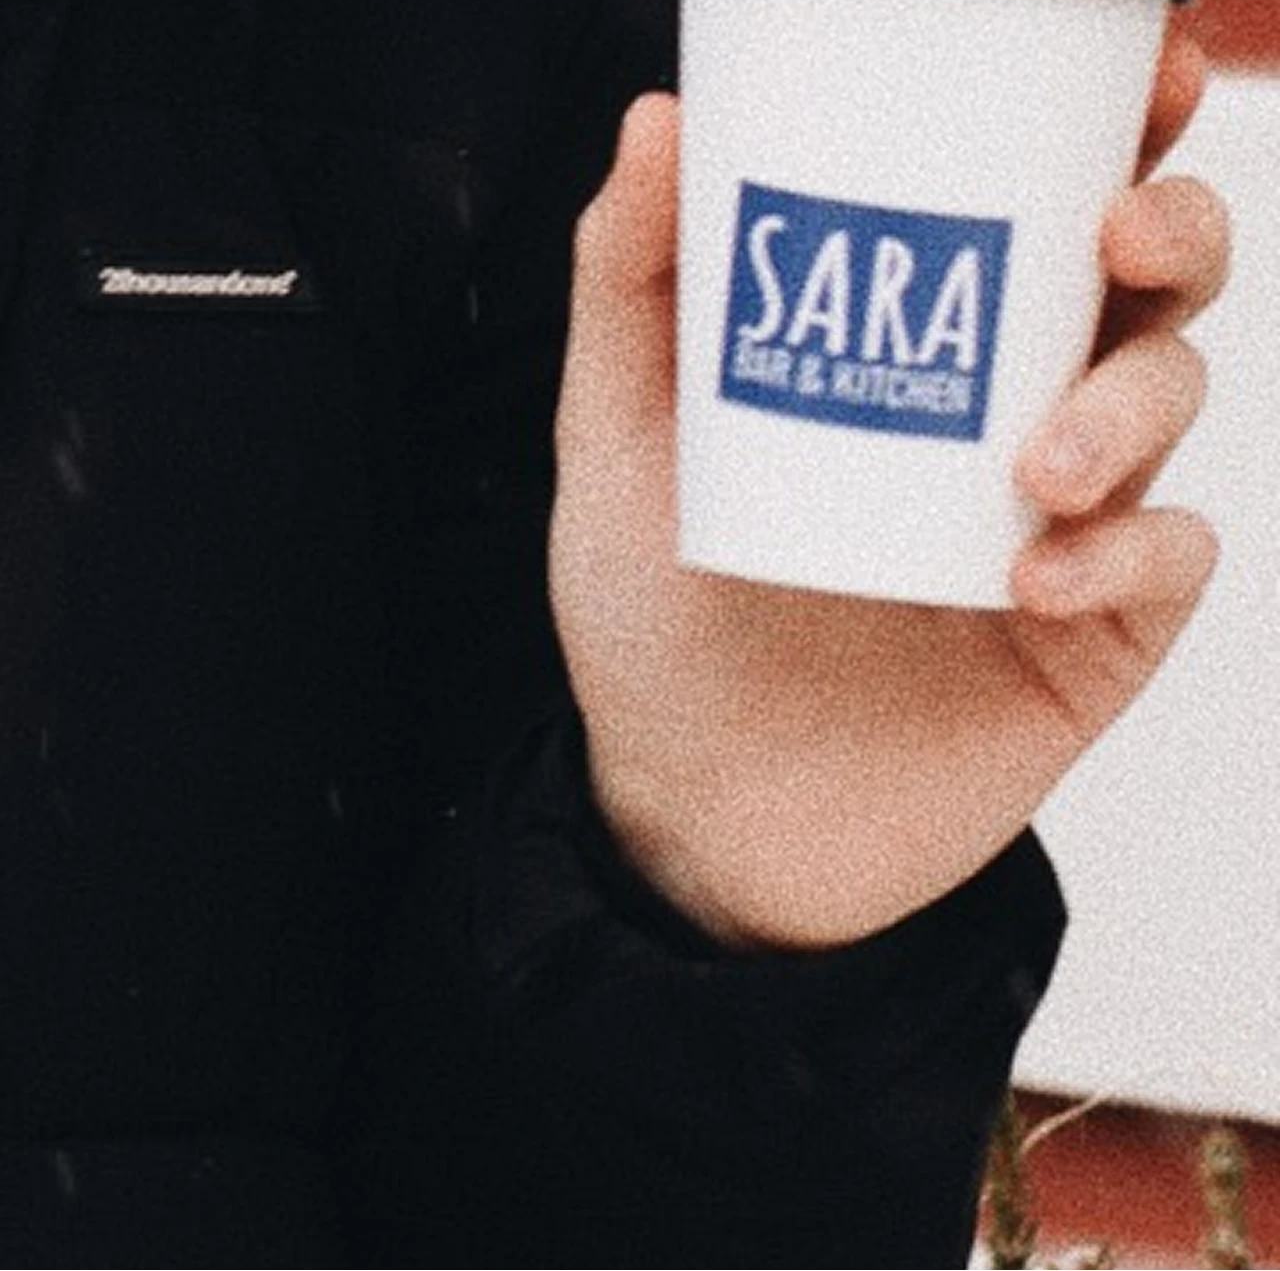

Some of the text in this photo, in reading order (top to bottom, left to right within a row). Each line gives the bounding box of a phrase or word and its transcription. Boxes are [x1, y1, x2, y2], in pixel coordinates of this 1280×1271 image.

[737, 215, 980, 372] SARA
[796, 355, 826, 394] &
[832, 360, 974, 414] KITCHEN
